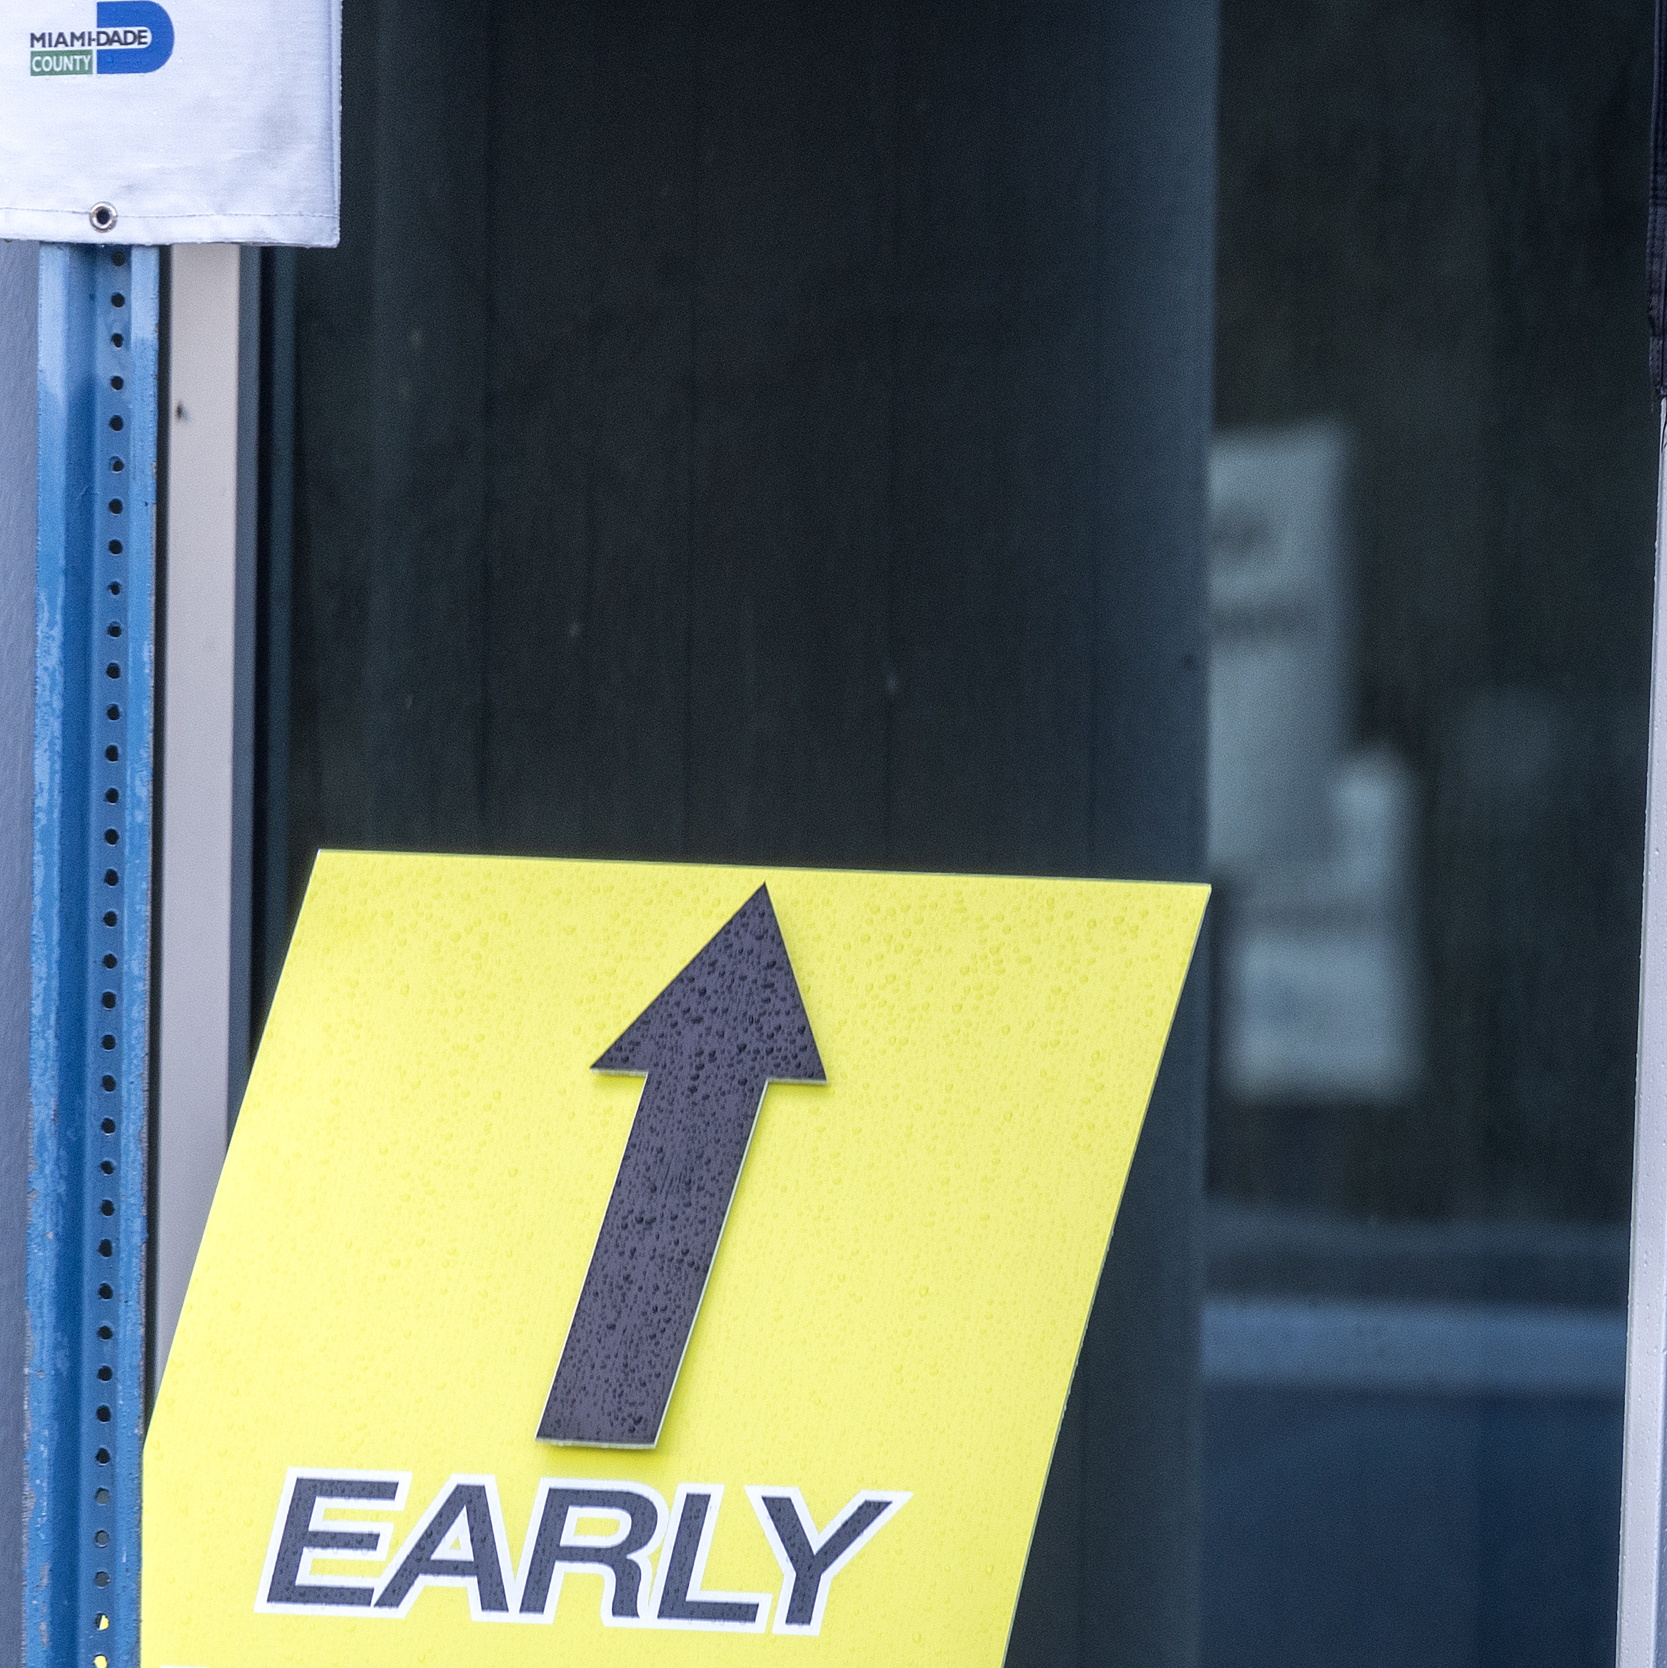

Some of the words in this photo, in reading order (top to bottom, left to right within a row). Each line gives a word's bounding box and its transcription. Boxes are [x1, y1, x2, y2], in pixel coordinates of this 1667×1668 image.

[29, 29, 149, 48] MIAMI-DADE
[31, 55, 92, 72] COUNTY
[256, 1470, 908, 1634] EARLY
